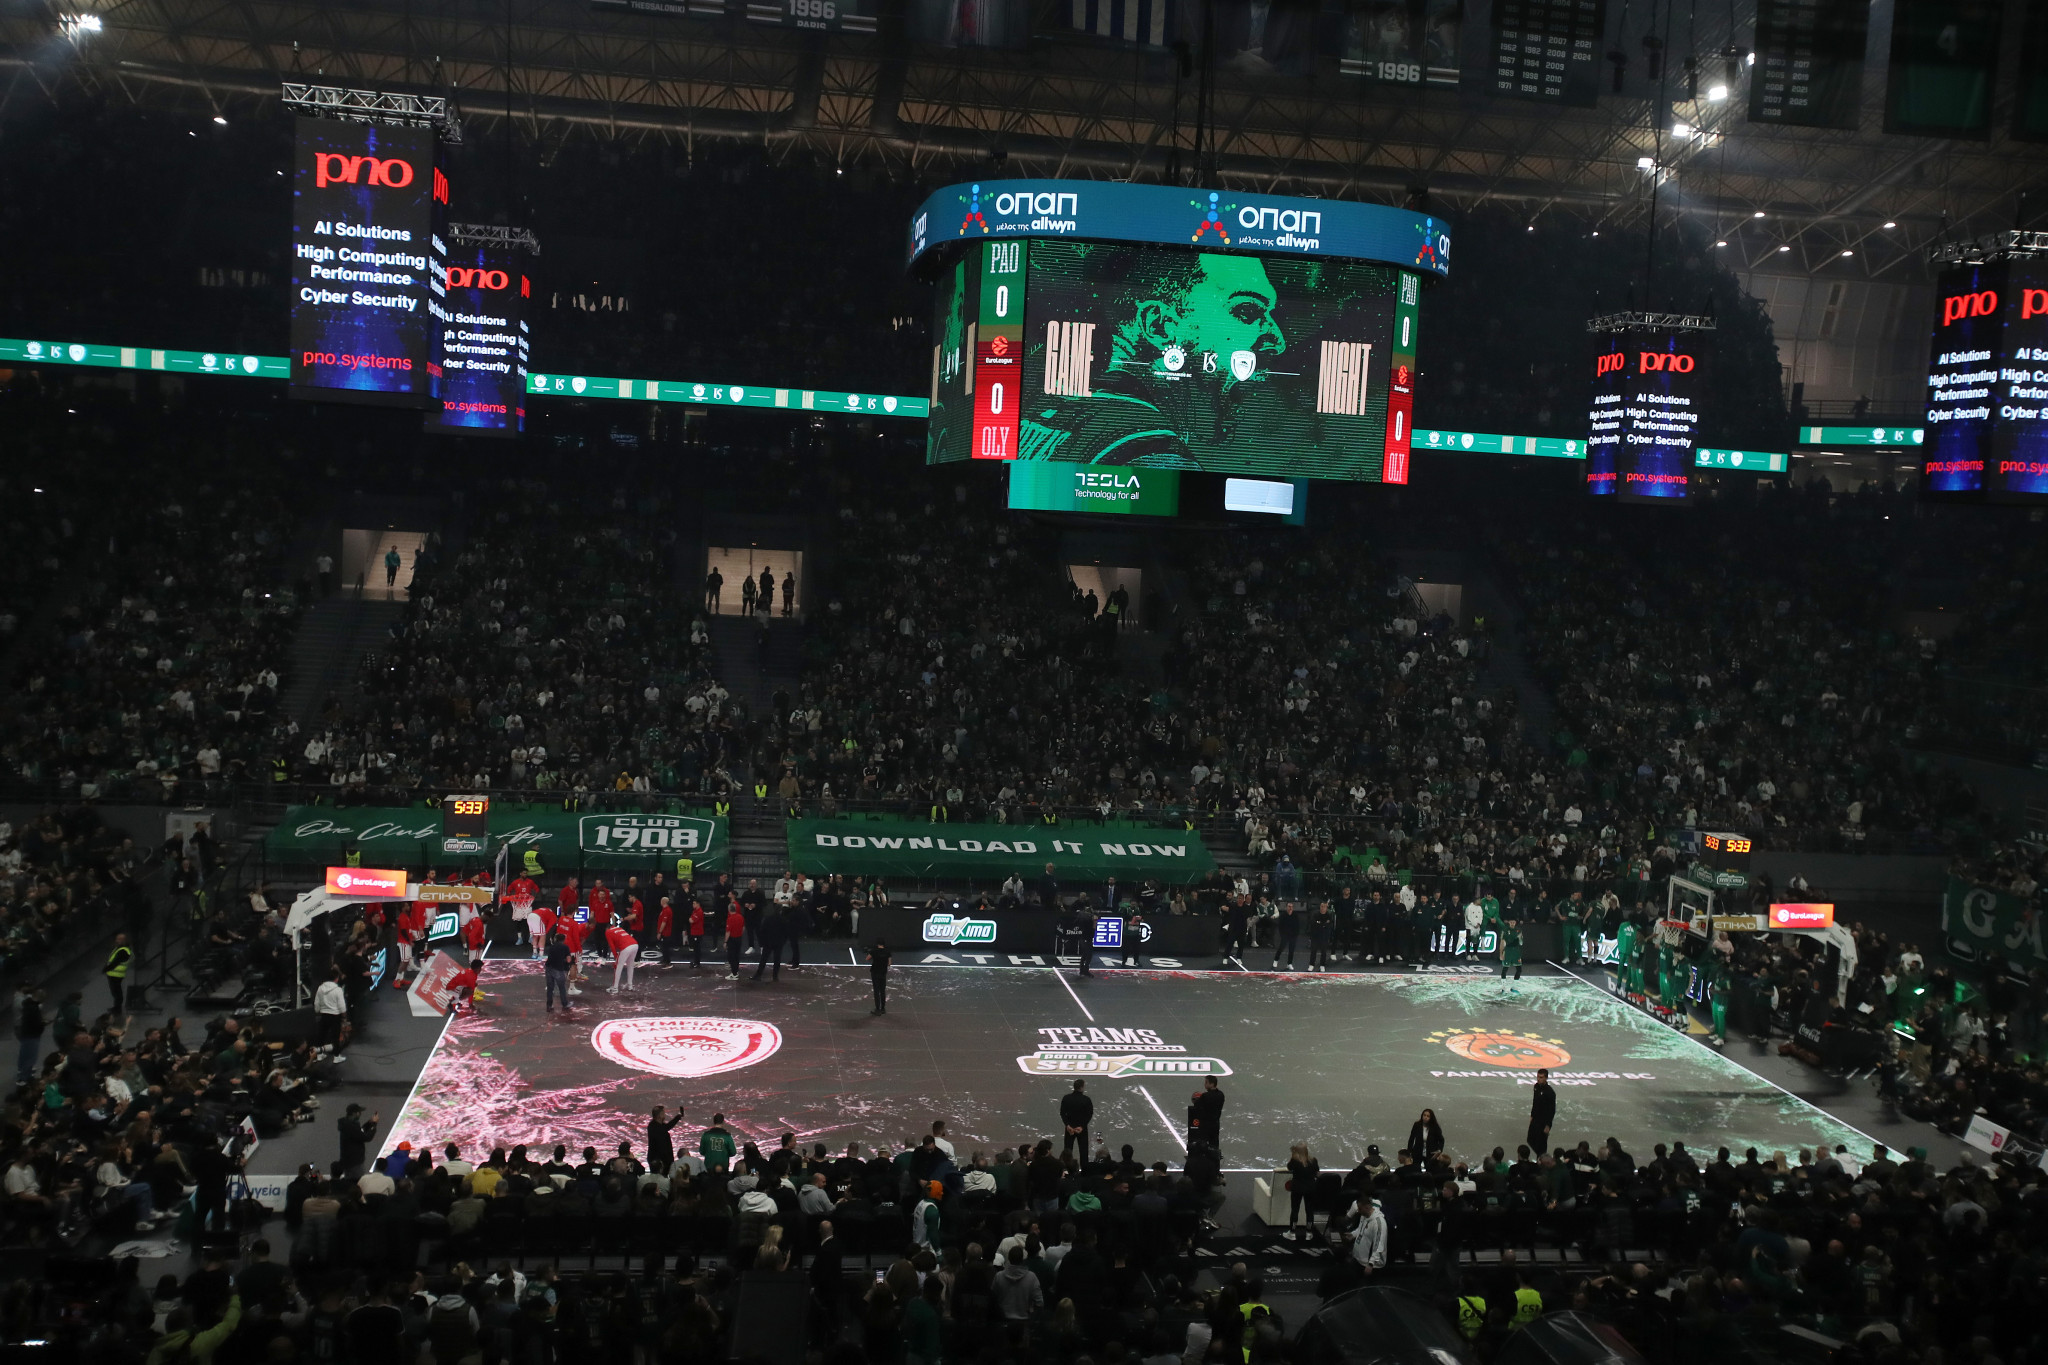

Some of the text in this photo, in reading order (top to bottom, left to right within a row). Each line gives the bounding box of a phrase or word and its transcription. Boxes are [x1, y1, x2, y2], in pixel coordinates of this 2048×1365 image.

[630, 1, 686, 13] THESSALONIKI
[789, 0, 836, 20] 1996
[1548, 36, 1568, 45] 2007
[1574, 40, 1592, 49] 2021
[1500, 42, 1592, 61] 1962 1982 2008 2024
[1499, 55, 1516, 65] 1967
[1545, 61, 1565, 71] 2009
[1377, 61, 1421, 83] 1996
[1545, 74, 1563, 83] 2010
[1498, 81, 1560, 96] 1971 1999 2011
[1789, 98, 1809, 106] 2025
[315, 152, 414, 188] pno
[314, 221, 412, 242] AI Solutions
[996, 223, 1030, 233] μέλος της
[1030, 216, 1077, 234] allwyn
[1238, 236, 1275, 247] μέλος της
[1275, 234, 1320, 252] allwyn
[297, 244, 335, 263] High
[338, 247, 426, 270] Computing
[989, 242, 1020, 274] PAO
[310, 264, 413, 285] Performance
[445, 266, 510, 291] pno
[1401, 273, 1418, 306] PAO
[300, 287, 349, 305] Cyber
[351, 291, 418, 312] Security
[995, 285, 1009, 318] 0
[1943, 290, 1998, 327] pno
[455, 313, 507, 326] Solutions
[457, 330, 517, 346] Computing
[1401, 316, 1410, 347] 0
[303, 351, 413, 371] pno.systems
[985, 357, 1013, 365] EuroLeague
[1043, 320, 1096, 398] GAME
[1938, 349, 1991, 365] AI Solutions
[2014, 347, 2031, 360] AI
[443, 358, 511, 374] ber Security
[1597, 352, 1625, 377] pno
[1639, 351, 1695, 374] pno
[1316, 340, 1373, 416] NIGHT
[1928, 369, 1998, 388] High Computing
[2000, 368, 2031, 384] High
[990, 382, 1004, 415] 0
[1600, 394, 1621, 403] Solutions
[1636, 393, 1691, 406] AI Solutions
[1934, 388, 1989, 401] Performance
[1589, 408, 1624, 421] High Computing
[1626, 407, 1698, 423] High Computing
[1927, 406, 1990, 424] Cyber Security
[2000, 405, 2039, 421] Cyber
[1395, 410, 1403, 442] 0
[1592, 421, 1620, 431] Performance
[1633, 420, 1690, 432] Performance
[981, 426, 1010, 457] OLY
[1588, 434, 1621, 447] Cyber Security
[1626, 433, 1692, 448] Cyber Security
[1388, 452, 1405, 482] OLY
[1925, 459, 1985, 475] pno.systems
[1075, 472, 1140, 489] TESLA
[1586, 472, 1617, 483] pno.systems
[1626, 472, 1688, 485] pno.systems
[1074, 488, 1140, 501] Technology for all
[454, 800, 484, 815] 5:33
[294, 820, 439, 841] One Club
[614, 818, 680, 828] CLUB
[495, 826, 553, 844] App
[594, 825, 699, 849] 1908
[815, 833, 1187, 858] DOWNLOAD IT NOW
[1726, 839, 1752, 853] 5:33
[352, 877, 396, 889] EuroLeague
[419, 891, 472, 901] ETIHAD
[1789, 911, 1825, 920] EuroLeague
[1713, 921, 1757, 931] ETIHAD
[618, 1020, 756, 1030] OLYMPIACOS
[637, 1026, 737, 1034] BASKETBALL
[1037, 1027, 1164, 1045] TEAMS
[1429, 1070, 1657, 1080] PANATHIAIKOS BC
